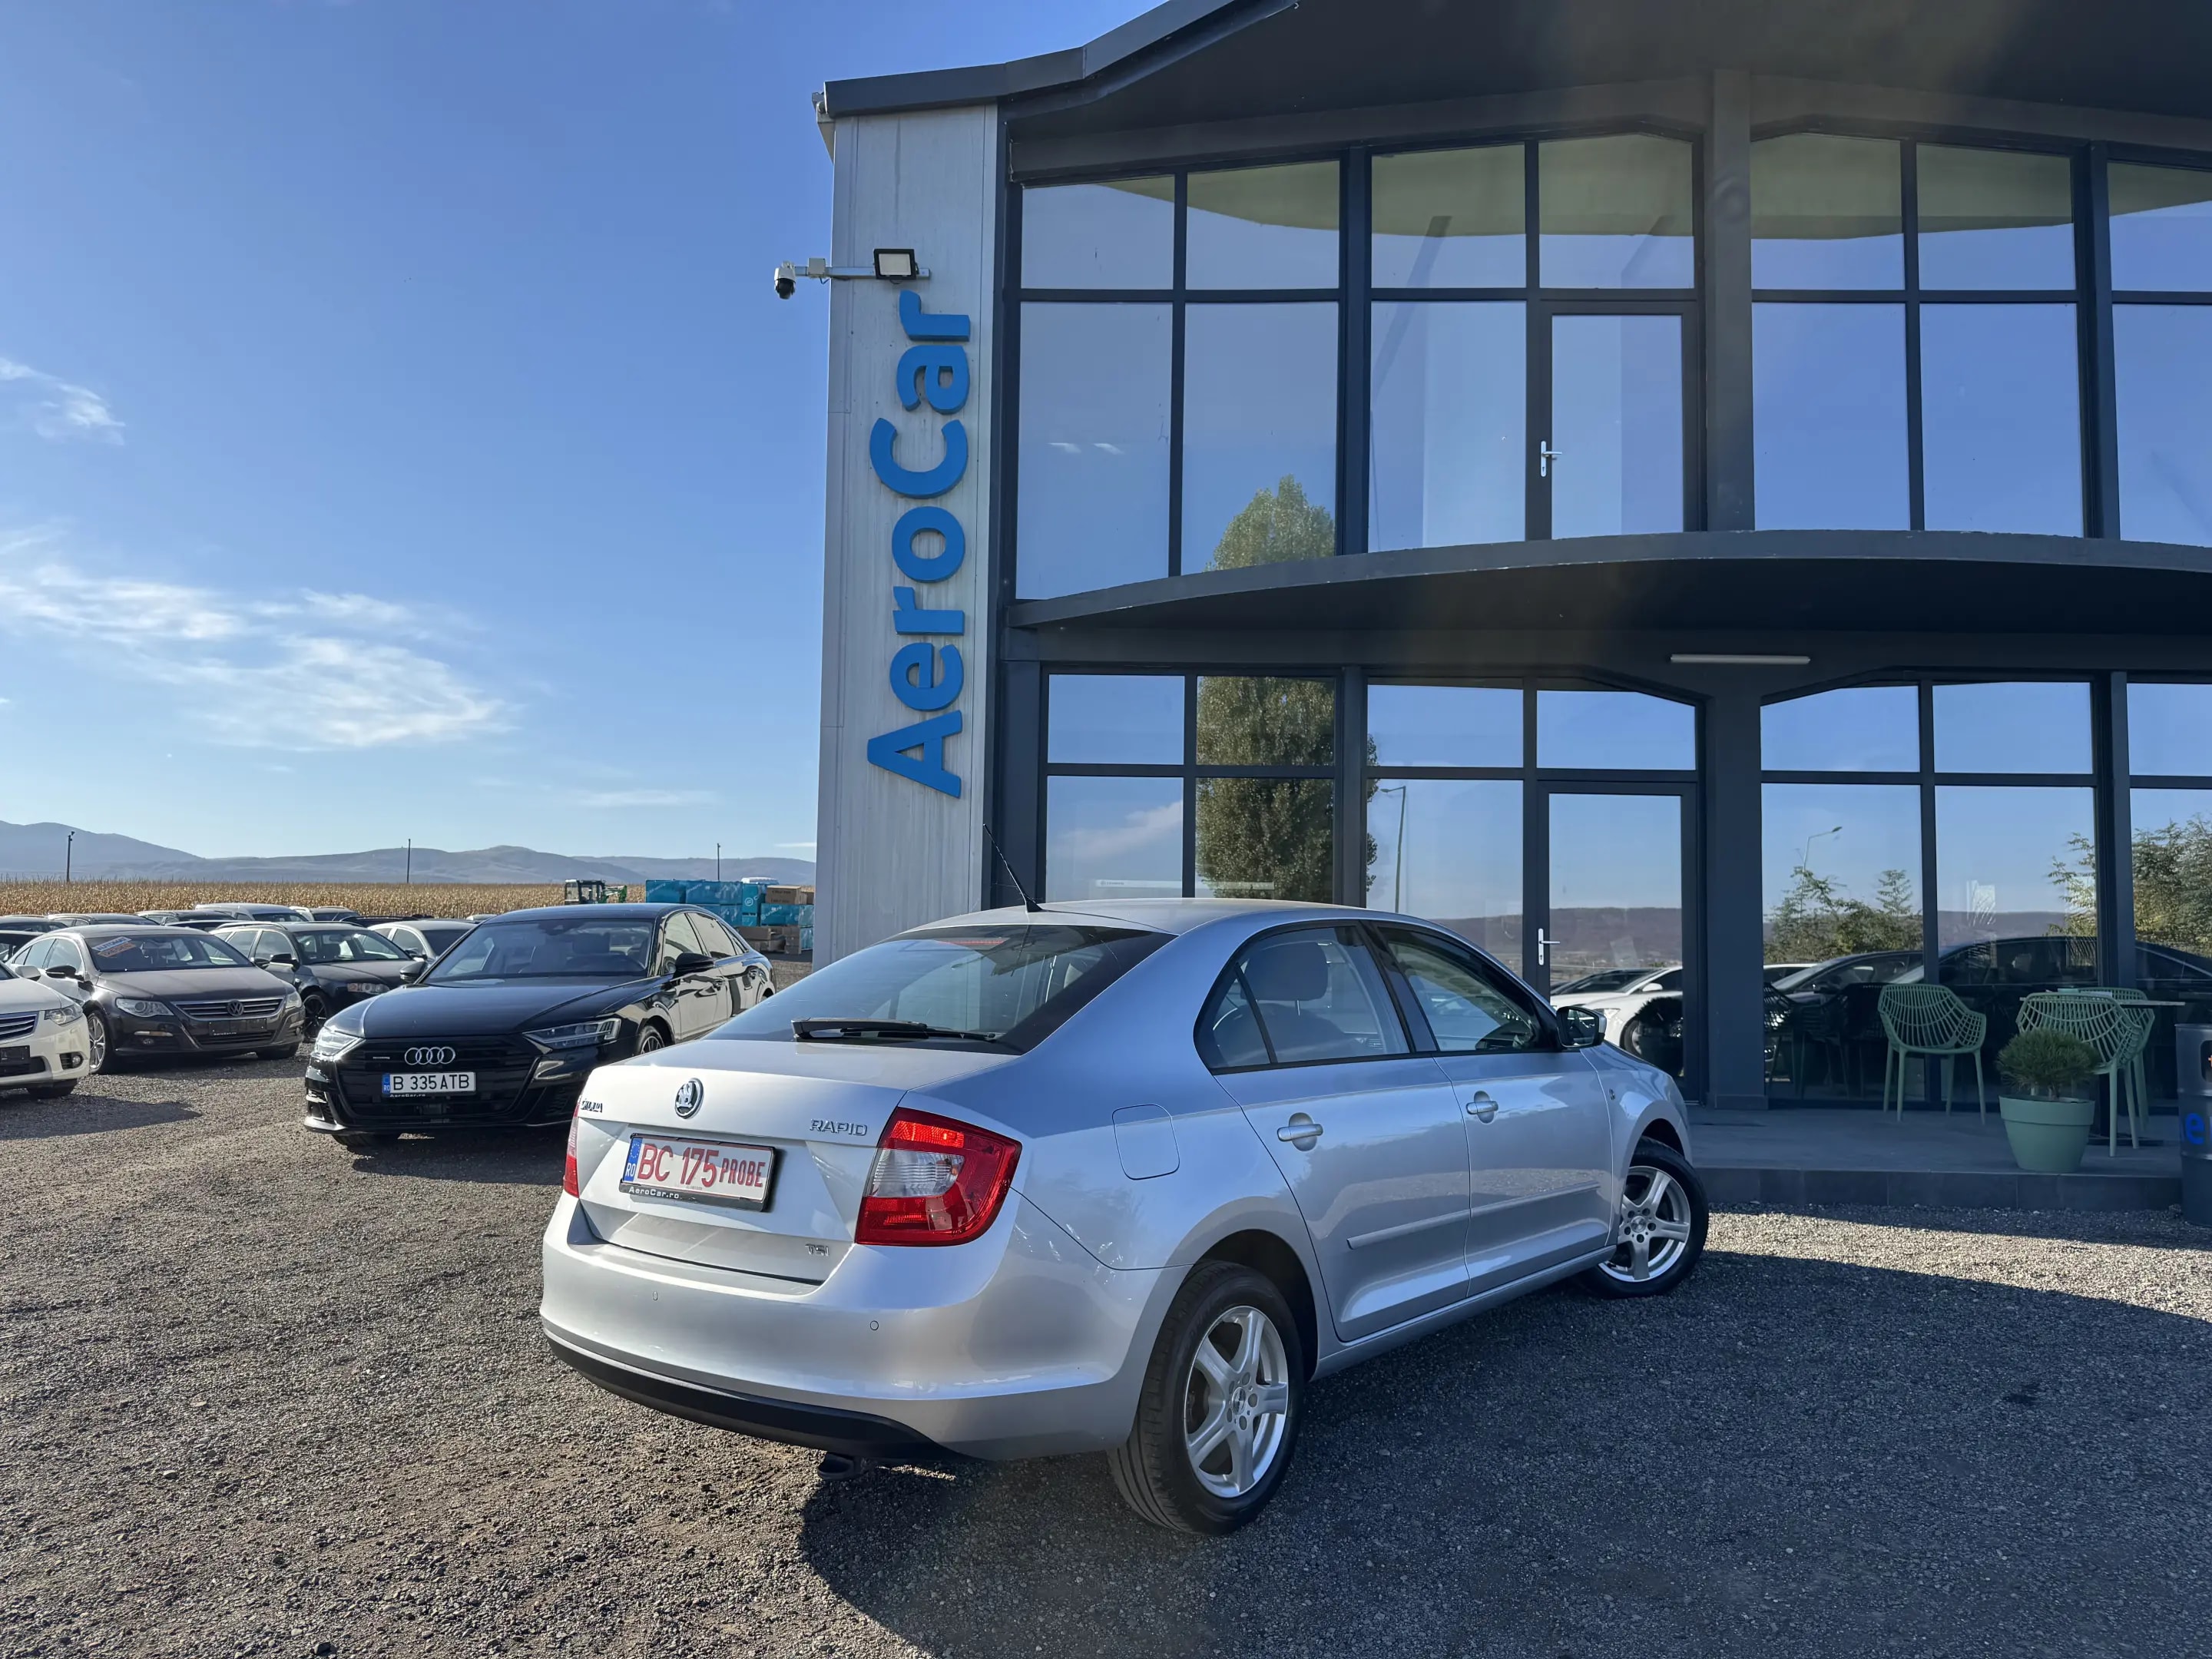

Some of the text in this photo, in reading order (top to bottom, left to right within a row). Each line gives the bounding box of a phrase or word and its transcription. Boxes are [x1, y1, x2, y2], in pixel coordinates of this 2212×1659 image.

[867, 290, 971, 799] AeroCar
[393, 1075, 469, 1091] B 335 ATB
[810, 1118, 868, 1136] RAPID
[625, 1162, 636, 1177] RO
[637, 1143, 766, 1188] BC 175 PROBE
[628, 1186, 680, 1200] AeroCar.ro
[805, 1243, 830, 1257] TSI
